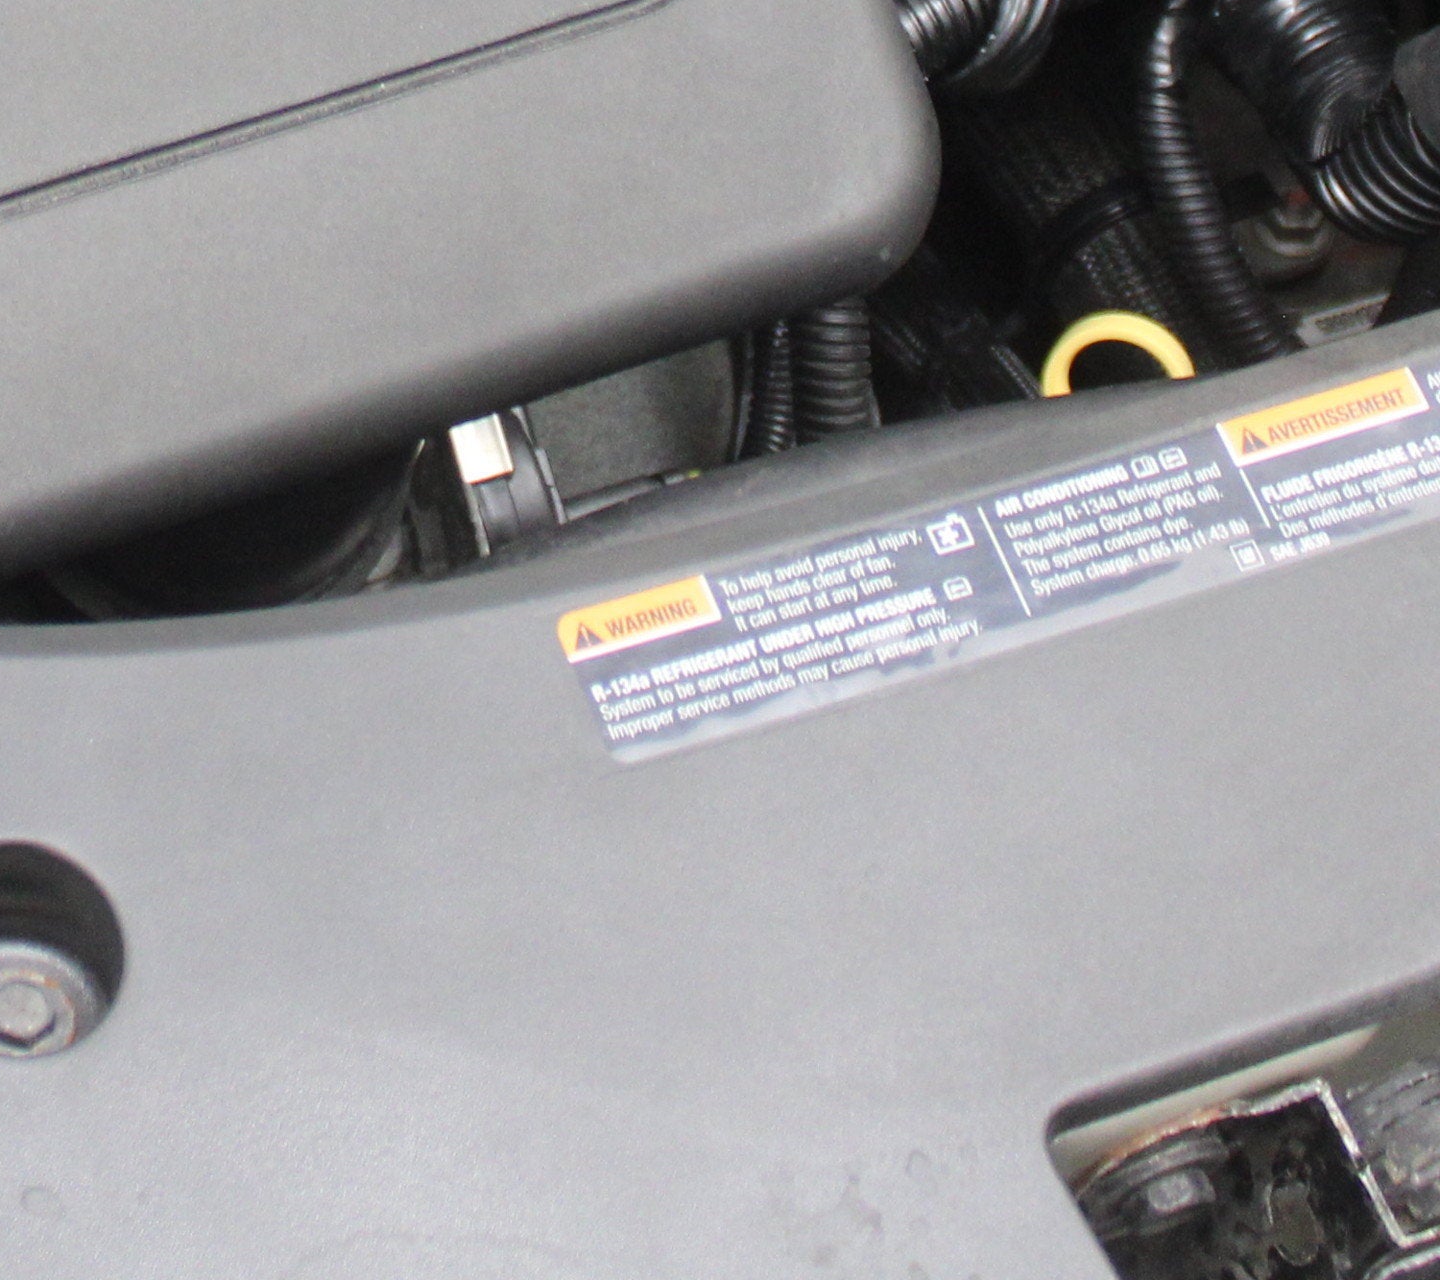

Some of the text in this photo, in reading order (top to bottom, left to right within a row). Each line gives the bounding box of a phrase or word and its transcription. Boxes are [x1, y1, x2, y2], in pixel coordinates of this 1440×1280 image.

[1268, 389, 1402, 440] AVERTISSEMENT
[995, 465, 1127, 516] AIR CONDITIONING
[1003, 461, 1221, 538] Use only R-134a Refrigerant and
[1261, 474, 1313, 502] FLUIDE
[1342, 482, 1361, 498] du
[1013, 484, 1223, 560] Polyalkylene Glycol oil (PAG oil).
[1021, 516, 1192, 575] The system contains dye.
[1278, 520, 1308, 538] Des
[718, 530, 921, 596] To help avoid personal injury,
[726, 556, 895, 613] keep hands clear of fan.
[1030, 569, 1084, 595] System
[1170, 537, 1193, 554] kg
[605, 600, 695, 636] WARNING
[748, 609, 776, 627] can
[778, 596, 812, 618] start
[813, 590, 830, 609] at
[831, 585, 858, 603] any
[859, 575, 896, 594] time.
[591, 588, 935, 701] R-134a REFRIGERANT UNDER HIGH PRESSURE
[599, 607, 950, 720] System to be serviced by qualified personnel only.
[607, 620, 978, 738] Improper service methods may cause personal injury.
